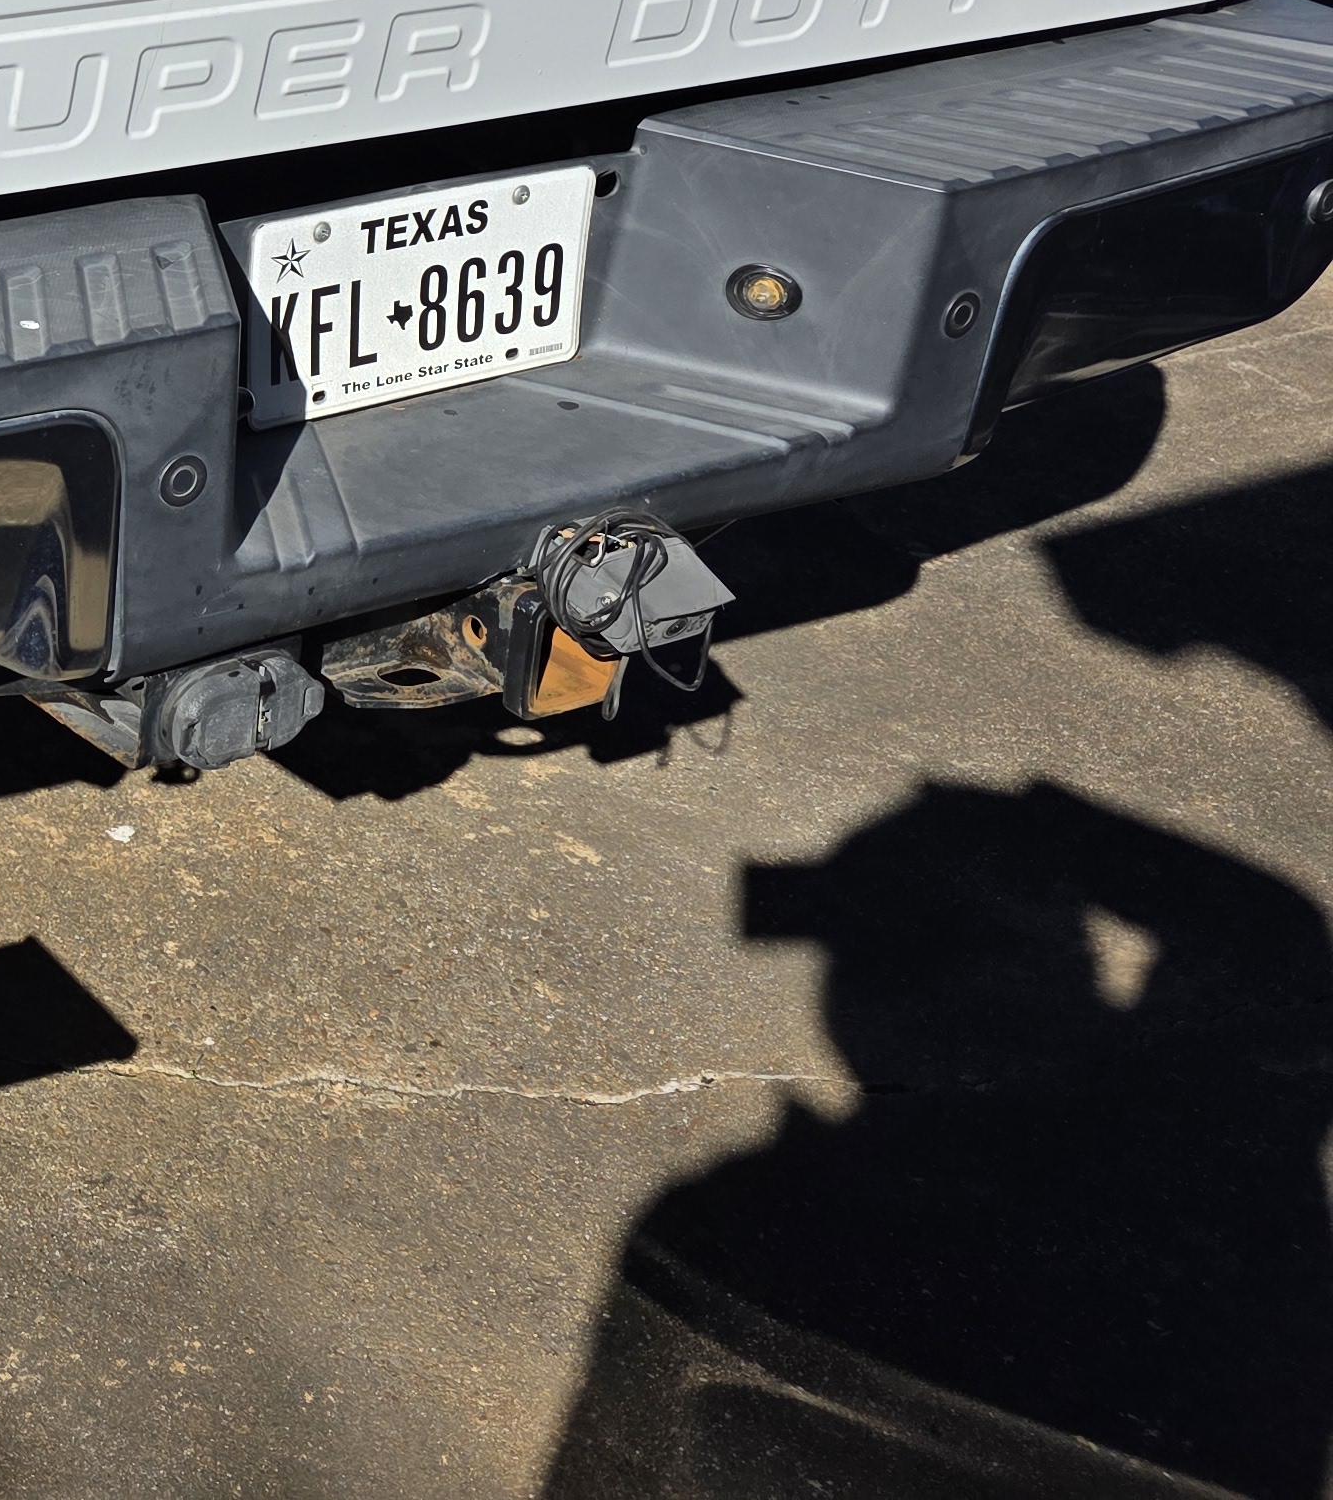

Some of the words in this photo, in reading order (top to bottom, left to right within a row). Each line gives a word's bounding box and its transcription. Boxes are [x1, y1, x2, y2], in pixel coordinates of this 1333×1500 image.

[360, 199, 489, 254] TEXAS
[270, 279, 378, 386] KFL
[417, 242, 565, 351] 8639
[342, 380, 371, 395] The
[376, 371, 413, 387] Lone
[418, 363, 450, 378] Star
[454, 353, 494, 370] State
